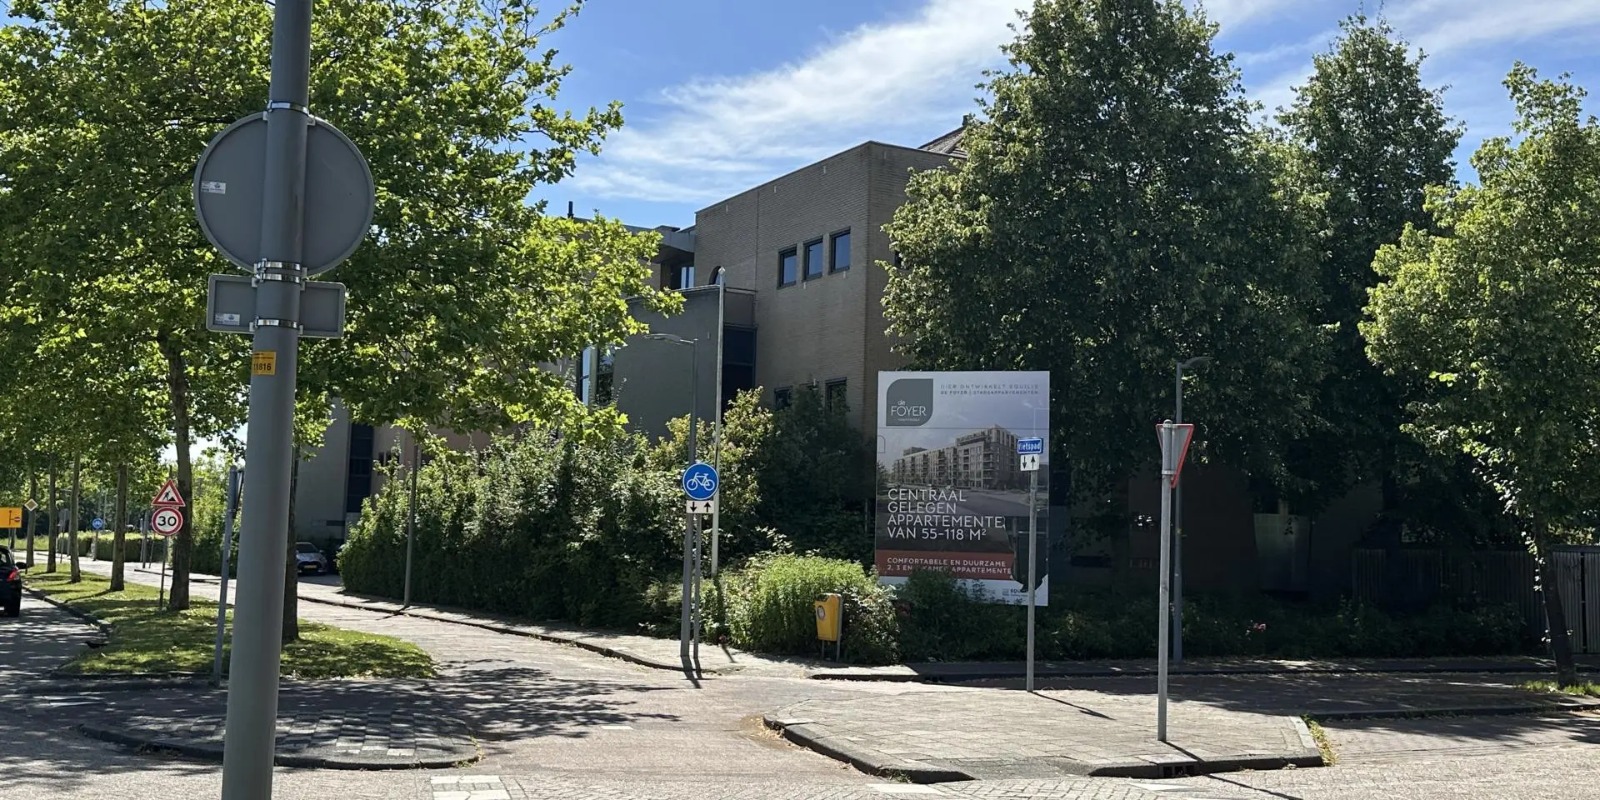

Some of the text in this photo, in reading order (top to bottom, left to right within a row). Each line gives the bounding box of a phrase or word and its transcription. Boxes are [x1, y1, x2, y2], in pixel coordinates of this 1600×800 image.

[890, 405, 927, 417] FOYER
[887, 488, 967, 502] CENTRAAL
[887, 501, 957, 514] GELEGEN
[158, 516, 177, 526] 30
[887, 514, 1006, 529] APPARTEMENTE
[887, 527, 916, 539] VAN
[921, 528, 964, 541] 55-118
[887, 557, 1006, 567] COMFORTABELE EN DUURZAME
